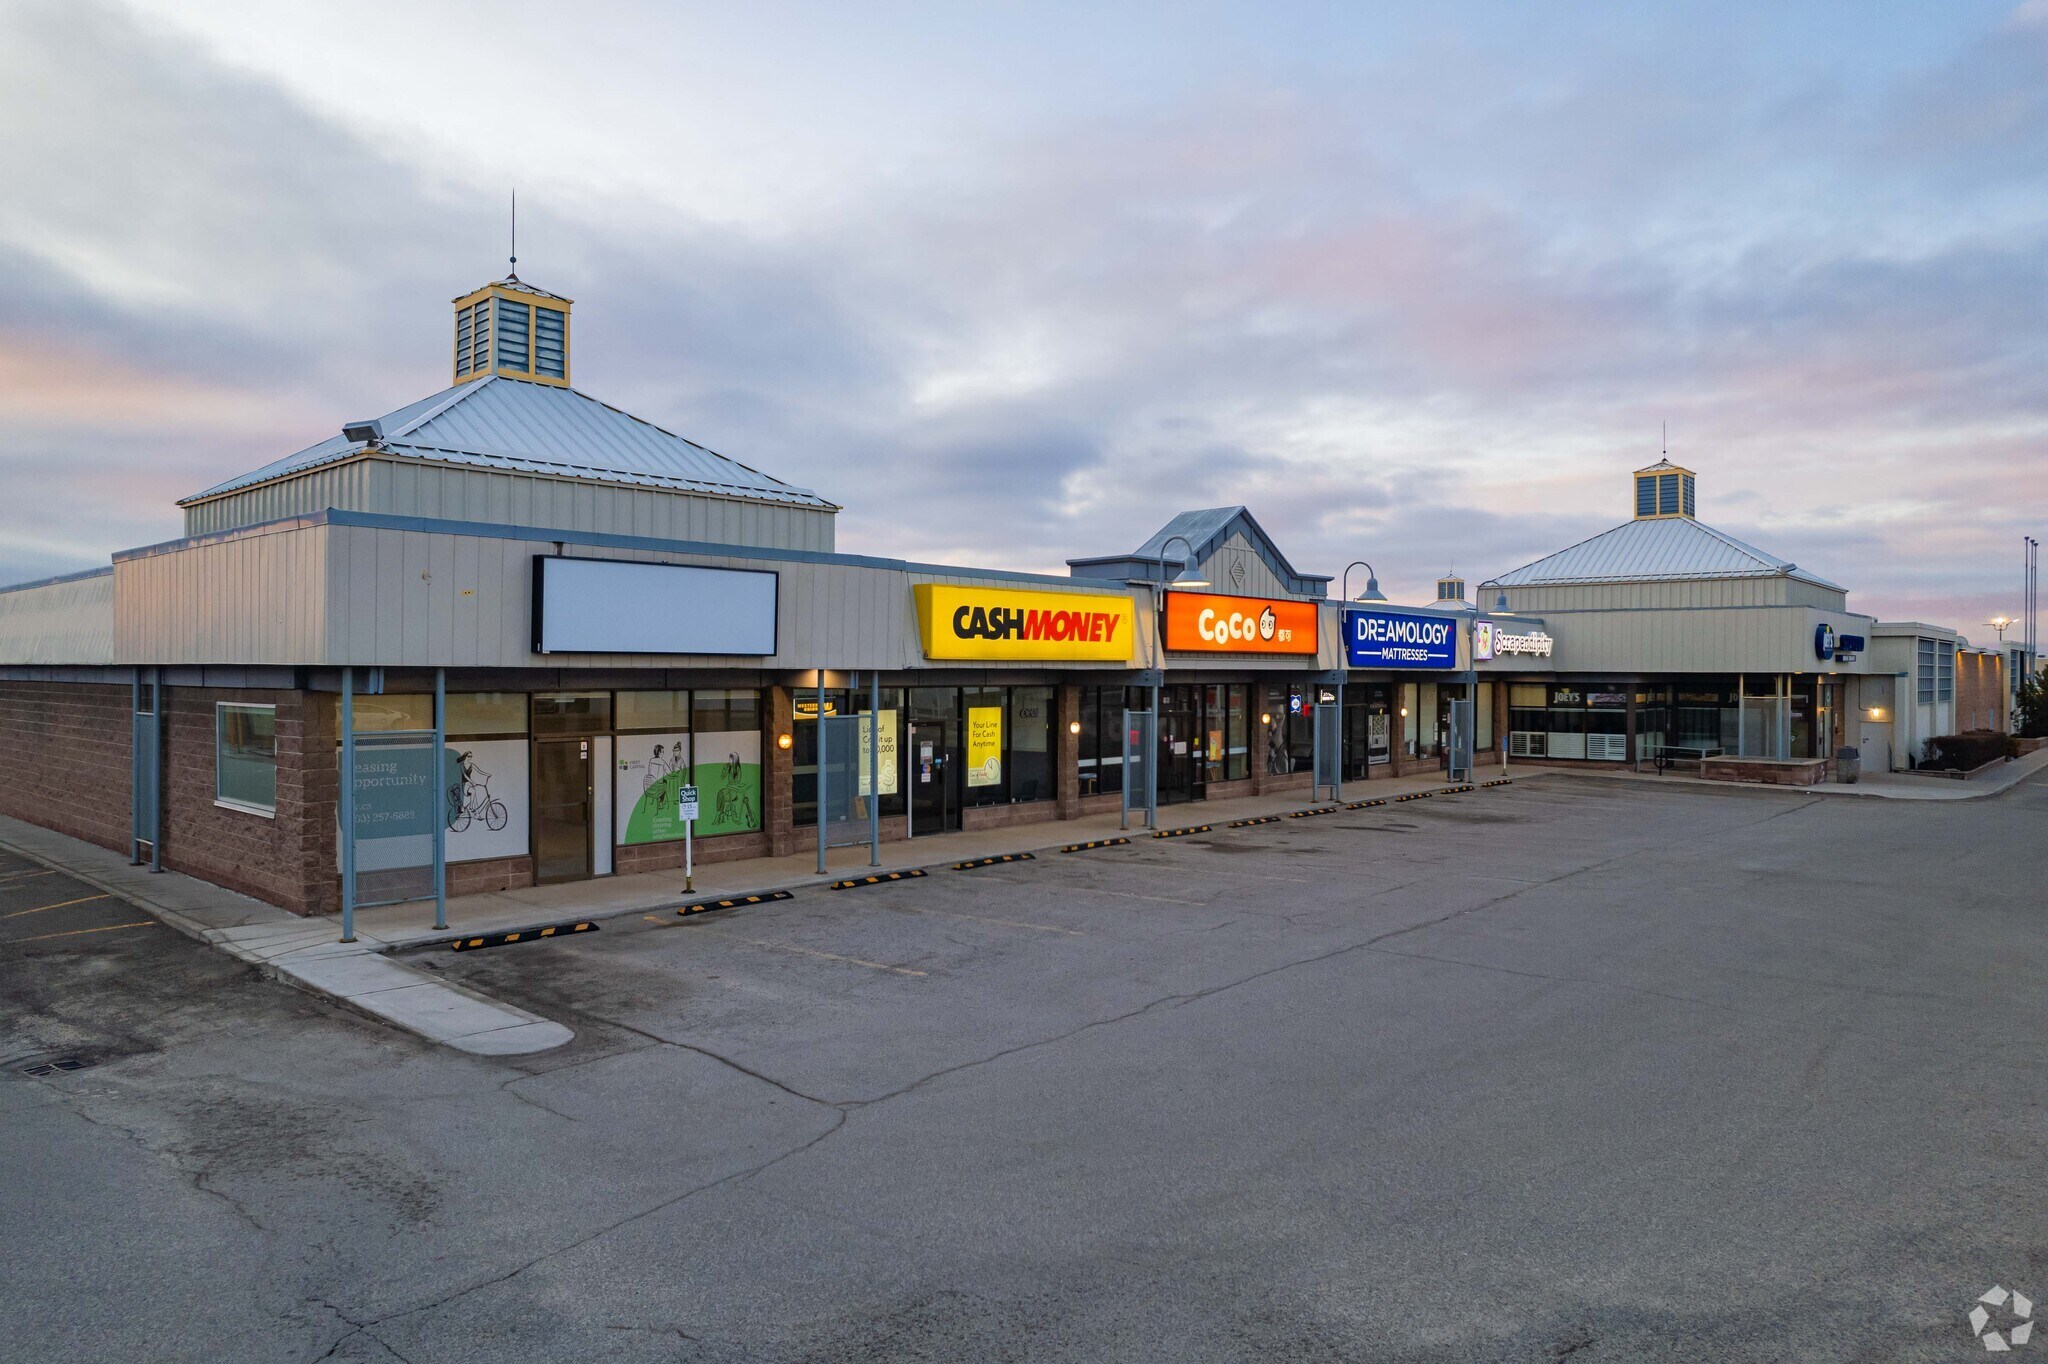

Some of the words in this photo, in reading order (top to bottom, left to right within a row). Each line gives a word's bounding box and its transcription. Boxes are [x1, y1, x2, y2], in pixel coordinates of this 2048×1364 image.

[1357, 617, 1449, 645] DREAMOLOGY
[1381, 647, 1428, 661] MATTRESSES
[1553, 692, 1580, 704] JOEY'S
[973, 721, 985, 729] Your
[986, 721, 998, 729] Line
[973, 741, 995, 749] Anytime
[355, 761, 397, 774] easing
